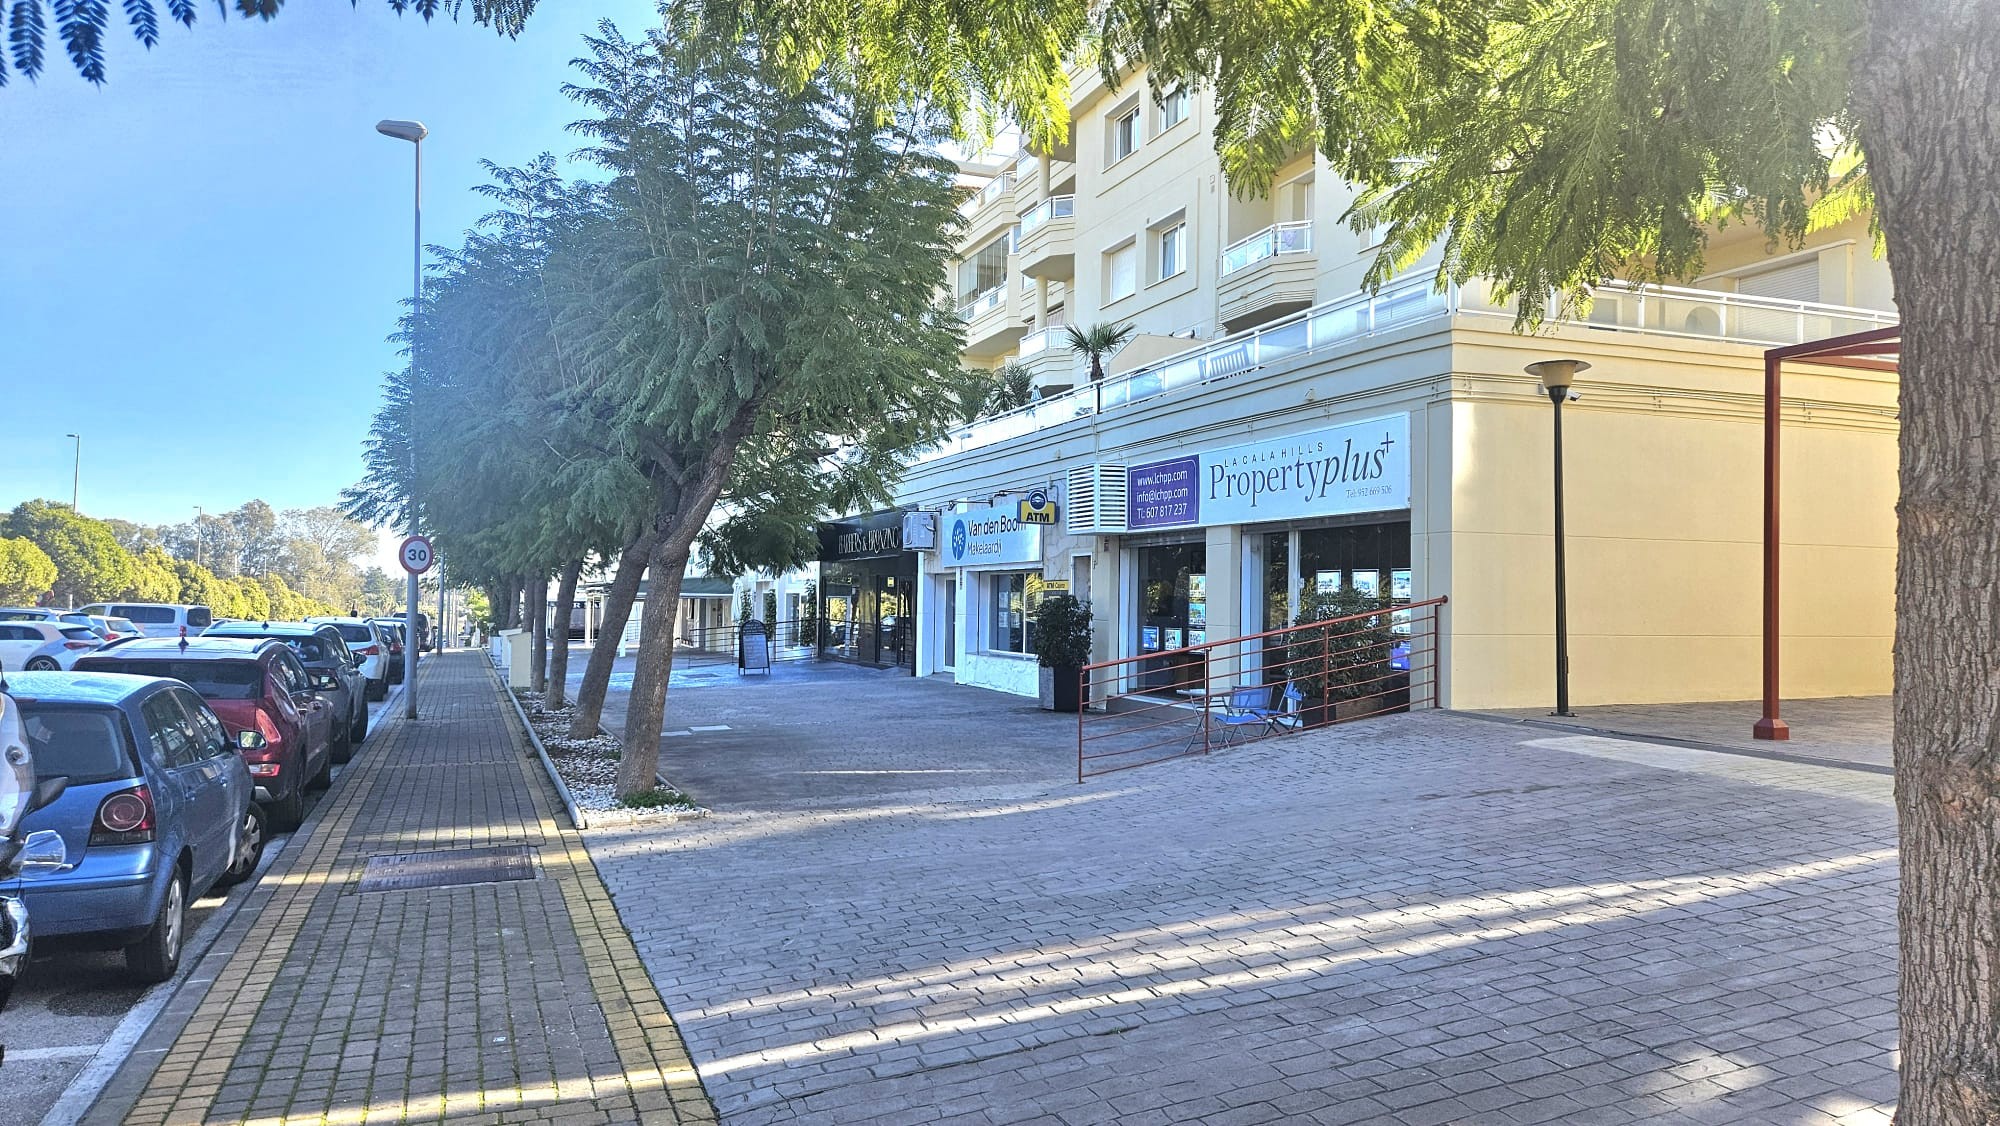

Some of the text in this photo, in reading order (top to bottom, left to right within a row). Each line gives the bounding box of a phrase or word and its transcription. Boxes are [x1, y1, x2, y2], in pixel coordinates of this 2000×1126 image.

[1137, 470, 1188, 486] www.lchpp.com
[1136, 487, 1188, 503] info@lchpp.com
[1026, 512, 1049, 522] ATM
[1146, 506, 1158, 518] 607
[1160, 504, 1172, 517] 817
[1174, 502, 1187, 516] 237
[968, 519, 982, 537] Van
[983, 517, 999, 535] den
[408, 549, 426, 561] 30
